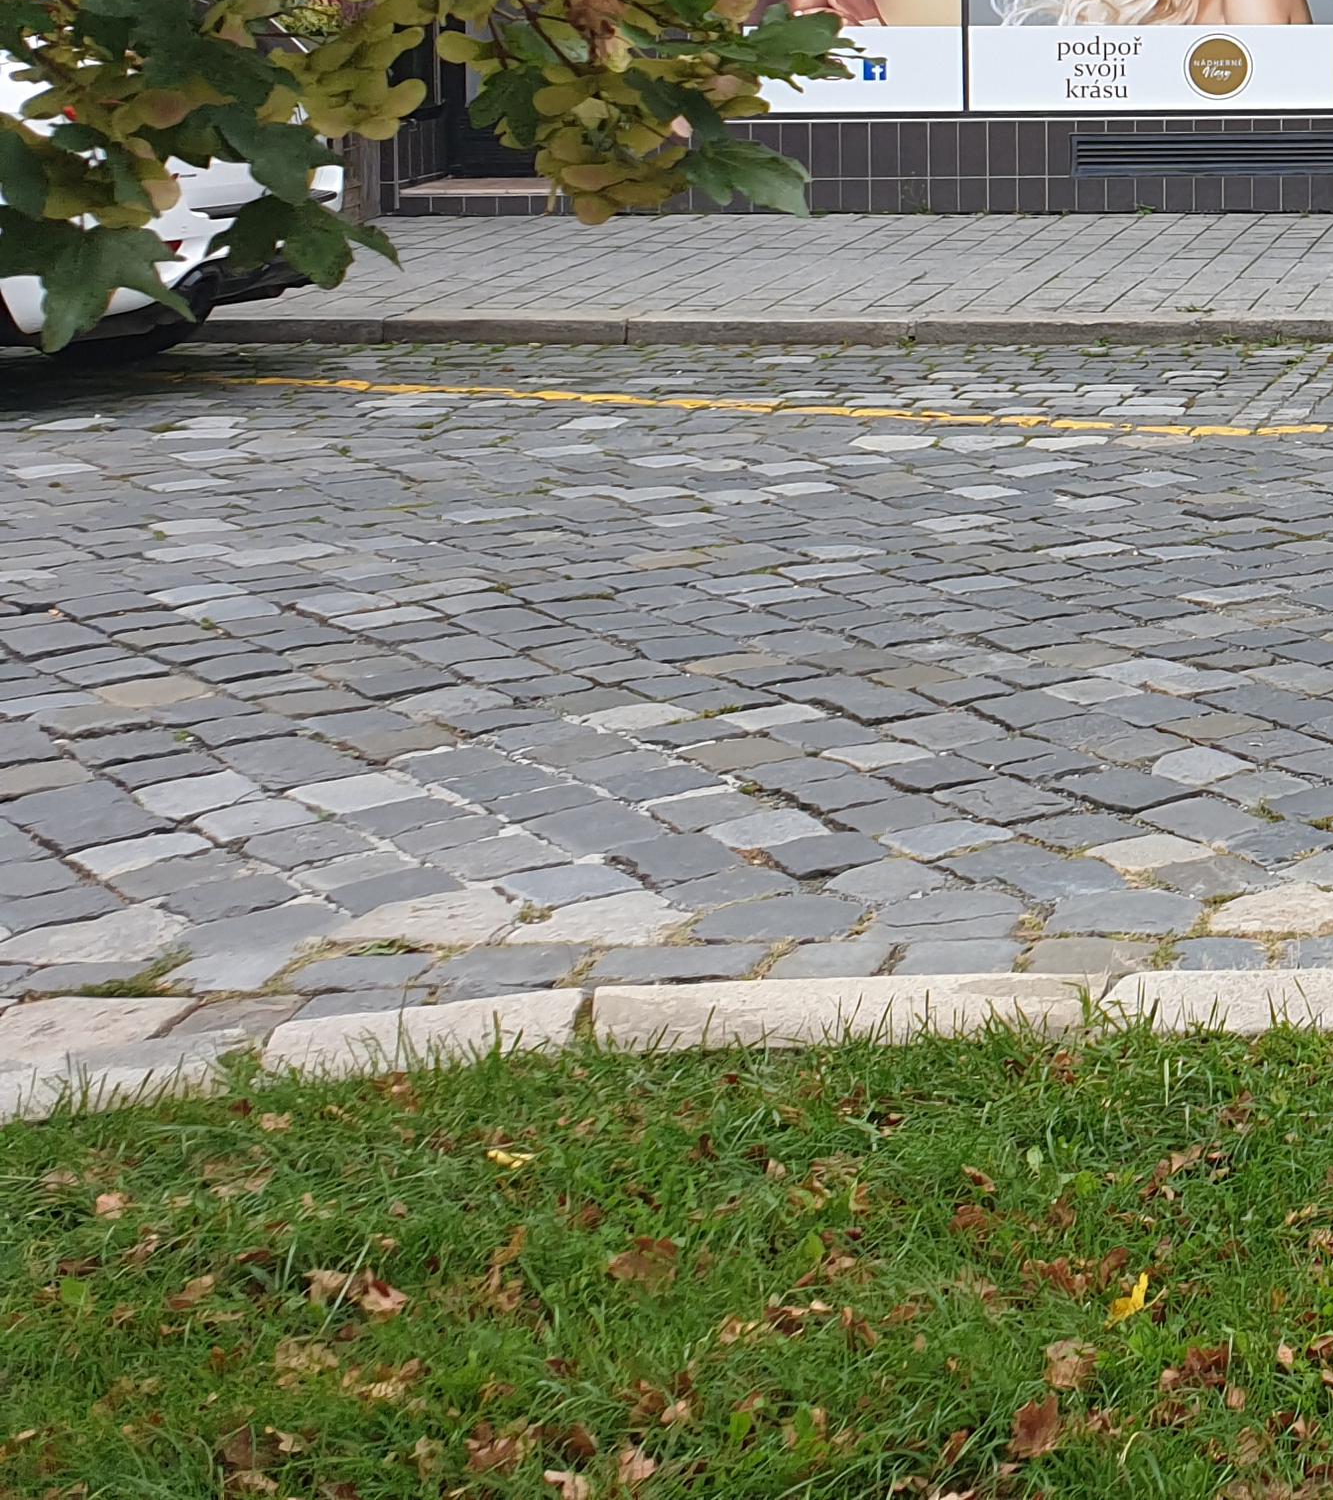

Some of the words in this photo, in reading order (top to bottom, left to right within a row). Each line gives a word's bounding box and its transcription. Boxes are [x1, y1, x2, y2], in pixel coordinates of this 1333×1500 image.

[1057, 36, 1143, 61] podpoř
[1073, 58, 1127, 82] svoji
[1065, 79, 1128, 99] krásu
